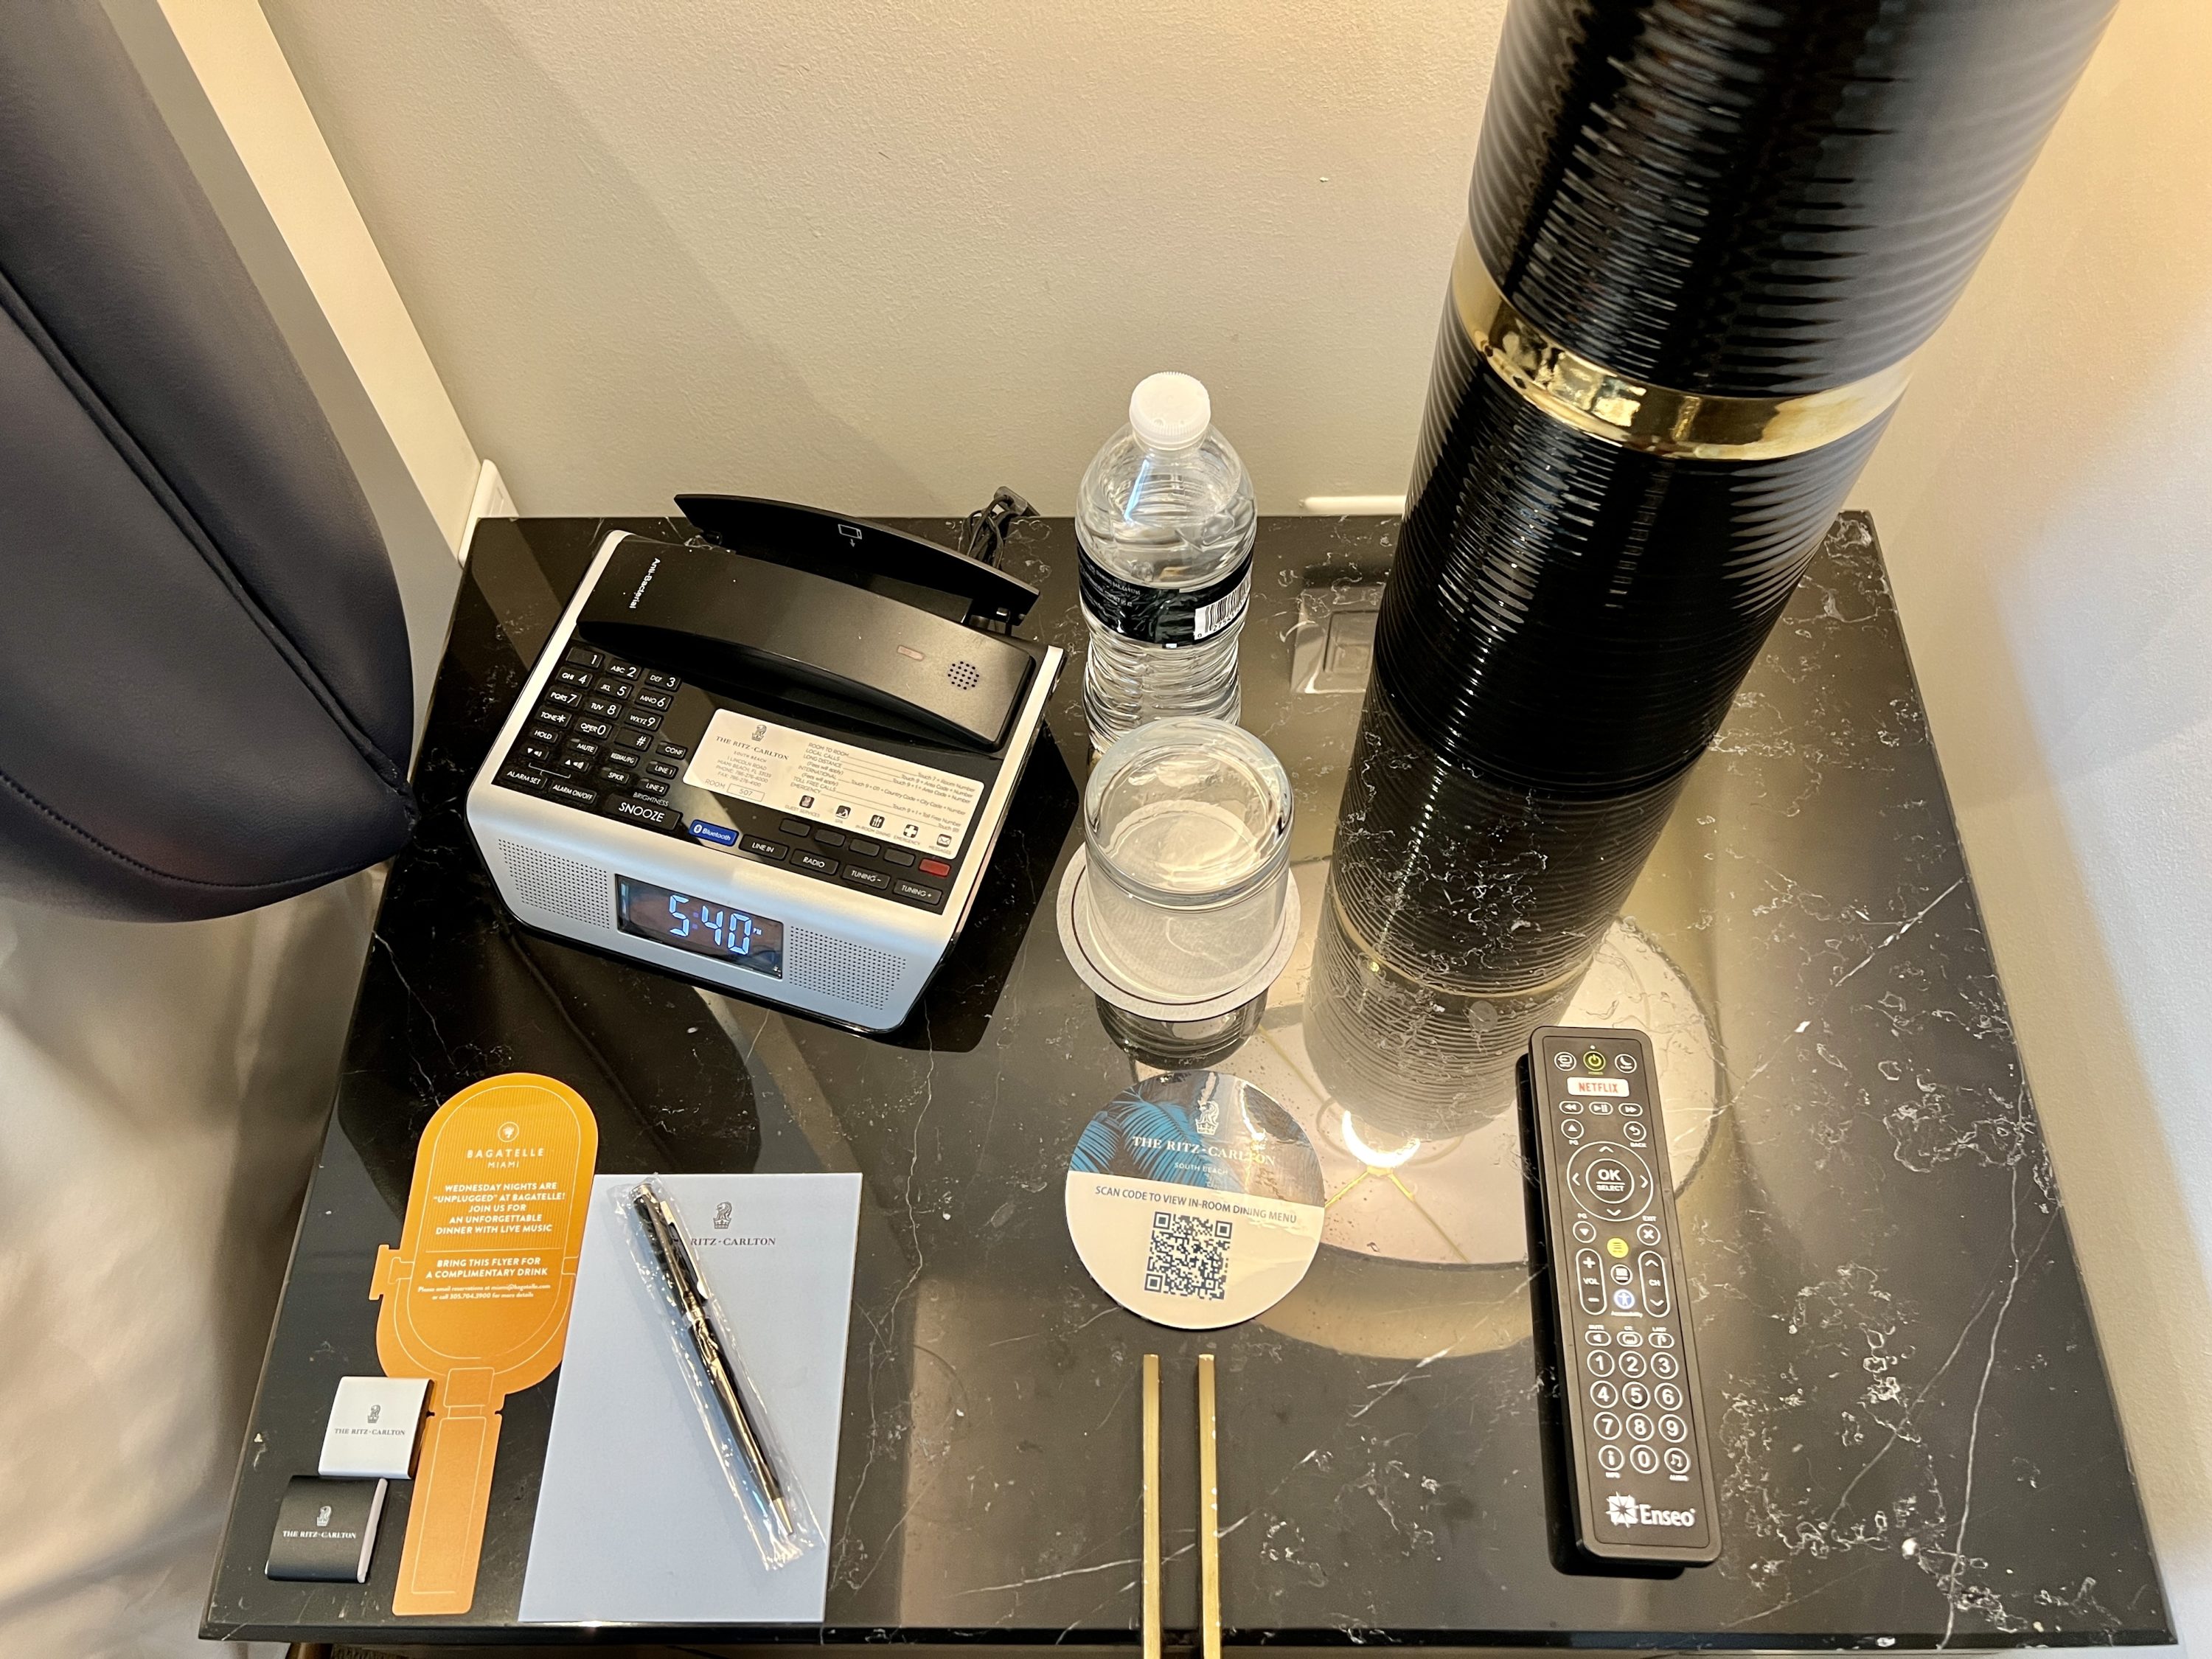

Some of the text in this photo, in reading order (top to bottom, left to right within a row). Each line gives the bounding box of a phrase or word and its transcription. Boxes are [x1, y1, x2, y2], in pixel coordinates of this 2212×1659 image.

[629, 558, 661, 608] Anti-Bacterial
[591, 655, 597, 665] 1
[627, 667, 637, 677] 2
[579, 675, 588, 684] 4
[667, 678, 676, 687] 3
[617, 686, 627, 696] 5
[550, 692, 577, 703] PQRS 7
[640, 695, 665, 707] MNO 6
[607, 705, 616, 715] 8
[541, 712, 557, 720] TONE
[630, 715, 655, 727] WXYZ 9
[580, 723, 606, 735] OPER 0
[535, 731, 552, 739] HOLD
[636, 736, 646, 745] #
[716, 736, 731, 744] THE
[577, 743, 594, 752] MUTE
[665, 746, 683, 756] CONF
[806, 748, 822, 757] LOCAL
[818, 758, 842, 768] DISTANCE
[655, 765, 669, 773] LINE
[507, 771, 530, 782] ALARM
[608, 772, 624, 781] SPKR
[646, 782, 659, 791] LINE
[705, 779, 726, 789] ROOM
[553, 785, 593, 800] ALARM ON/OFF
[633, 792, 669, 807] BRIGHTNESS
[619, 802, 665, 822] SNOOZE
[702, 827, 731, 841] Bluetooth
[752, 842, 765, 851] LINE
[803, 856, 825, 868] RADIO
[851, 870, 876, 882] TUNING
[902, 885, 926, 897] TUNING
[669, 894, 751, 955] 5:40
[1579, 1082, 1618, 1093] NETFLIX
[1132, 1136, 1162, 1149] THE
[467, 1147, 544, 1158] BAGATELLE
[1175, 1162, 1228, 1175] SOUTH BEACH
[1598, 1169, 1621, 1181] OK
[445, 1183, 501, 1192] WEDNESDAY
[503, 1183, 537, 1191] NIGHTS
[512, 1192, 566, 1200] BAGATELLE!
[469, 1205, 492, 1213] JOIN
[493, 1204, 505, 1212] US
[1095, 1186, 1297, 1223] SCAN CODE TO VIEW IN-ROOM DINING MENU
[449, 1214, 542, 1224] AN UNFORGETTABLE
[436, 1224, 552, 1235] DINNER WITH LIVE MUSIC
[437, 1257, 541, 1267] BRING THIS FLYER FOR
[435, 1269, 515, 1278] COMPLIMENTARY
[518, 1267, 548, 1276] DRINK
[1595, 1355, 1604, 1371] 1
[1626, 1356, 1639, 1372] 2
[1658, 1357, 1671, 1373] 3
[1597, 1386, 1610, 1402] 4
[1631, 1388, 1644, 1404] 5
[1662, 1389, 1674, 1405] 6
[1601, 1418, 1614, 1434] 7
[1634, 1419, 1646, 1436] 8
[1666, 1420, 1679, 1436] 9
[1638, 1452, 1650, 1467] 0
[1640, 1504, 1694, 1526] Enseo
